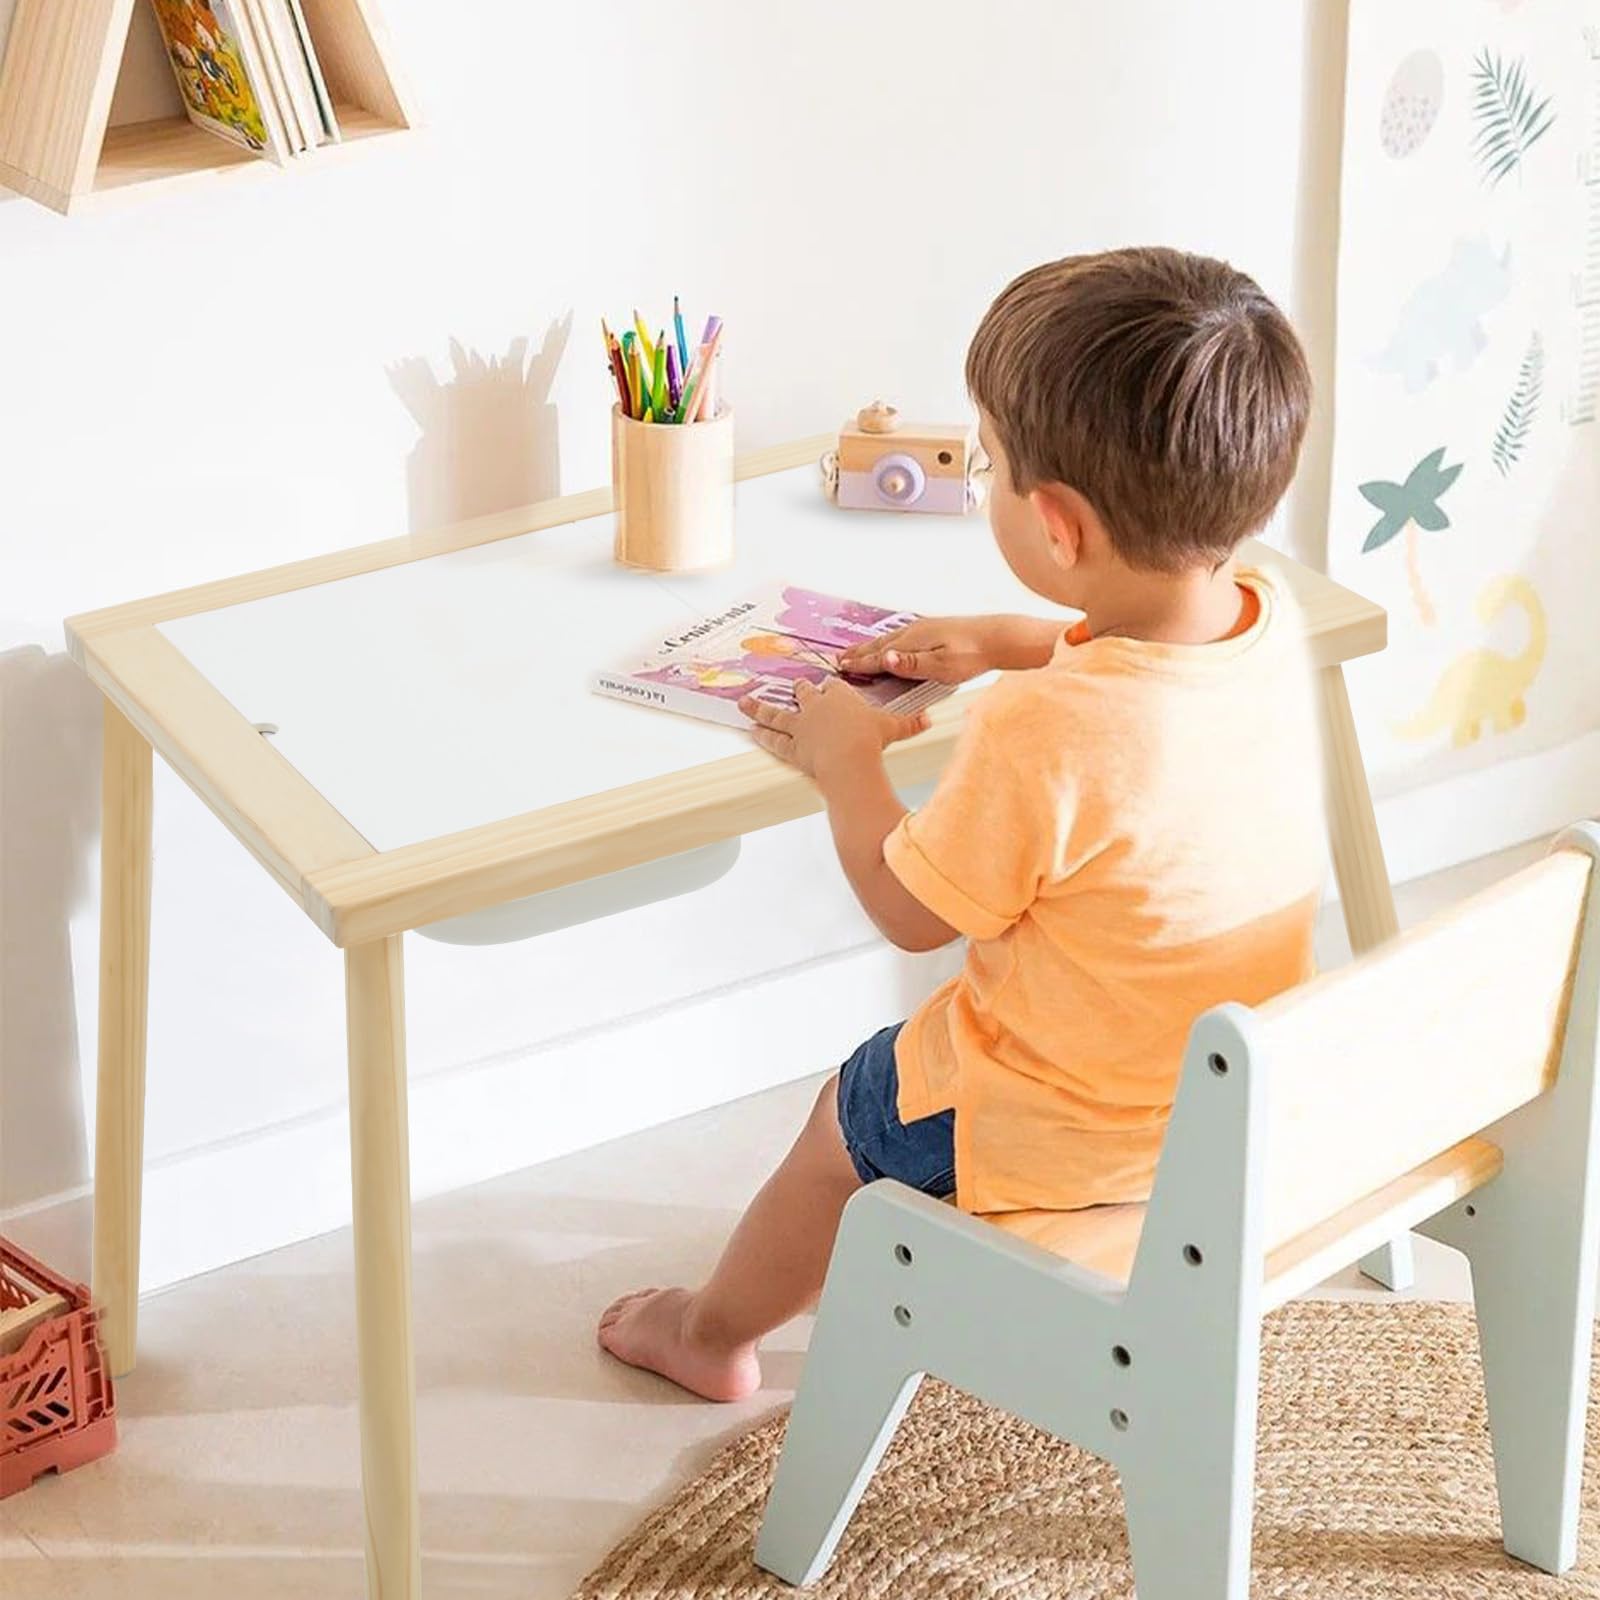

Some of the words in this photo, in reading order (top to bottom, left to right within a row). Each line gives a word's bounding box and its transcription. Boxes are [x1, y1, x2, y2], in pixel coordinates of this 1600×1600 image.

[664, 603, 756, 647] Cenicienta
[599, 680, 651, 699] Cenicienta
[653, 691, 665, 703] La
